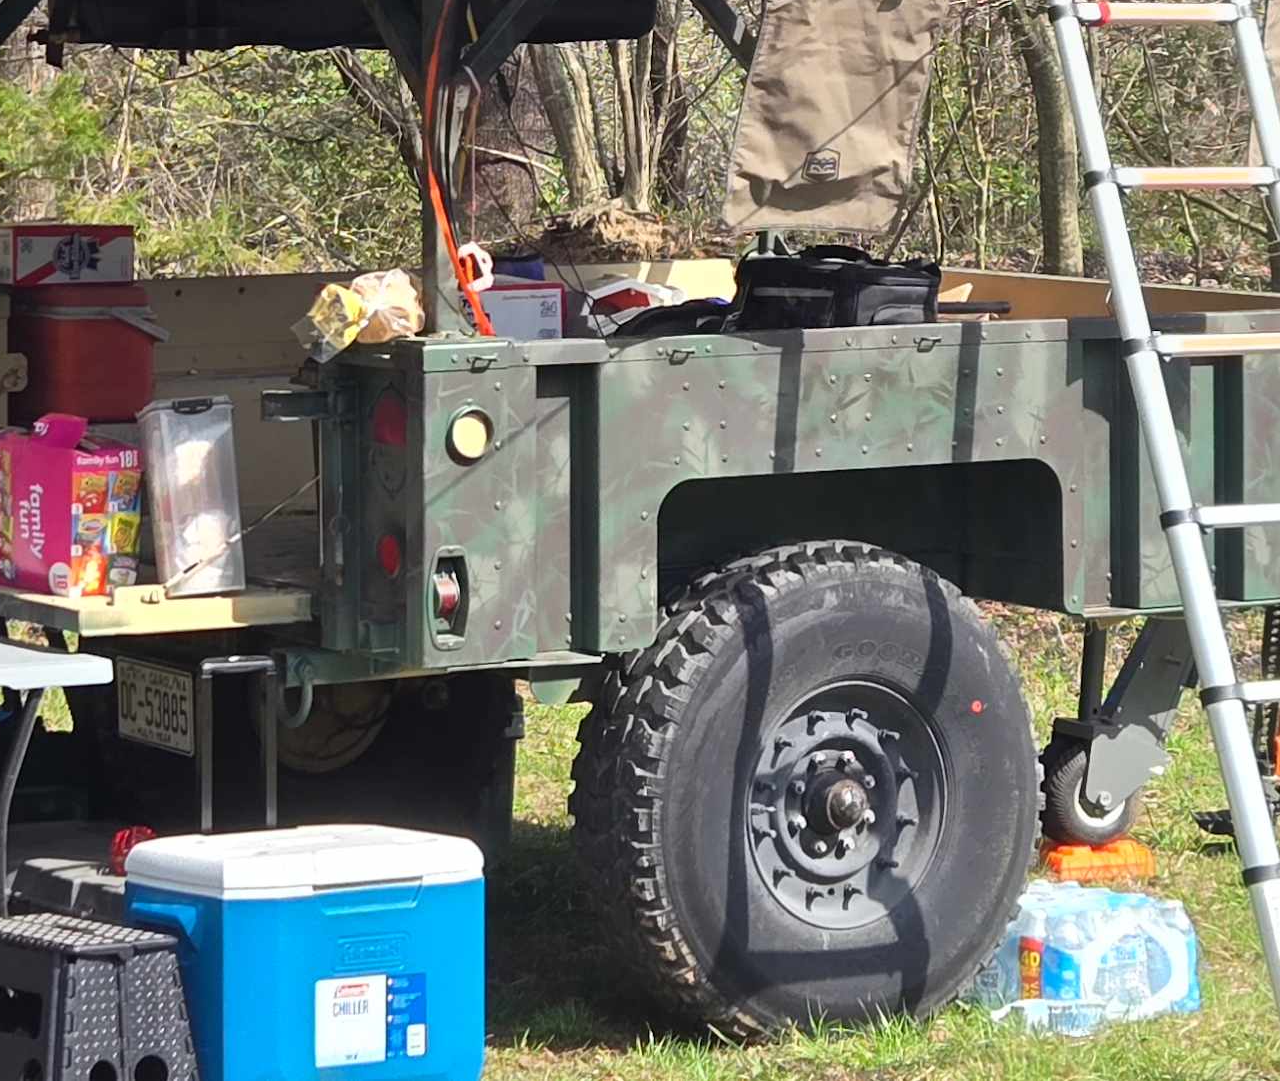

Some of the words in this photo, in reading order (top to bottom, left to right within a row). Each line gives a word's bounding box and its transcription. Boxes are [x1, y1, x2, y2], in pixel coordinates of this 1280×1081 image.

[76, 454, 104, 468] family
[105, 454, 119, 465] fun
[19, 500, 31, 539] fun
[29, 483, 45, 560] family
[332, 999, 369, 1017] CHILLER
